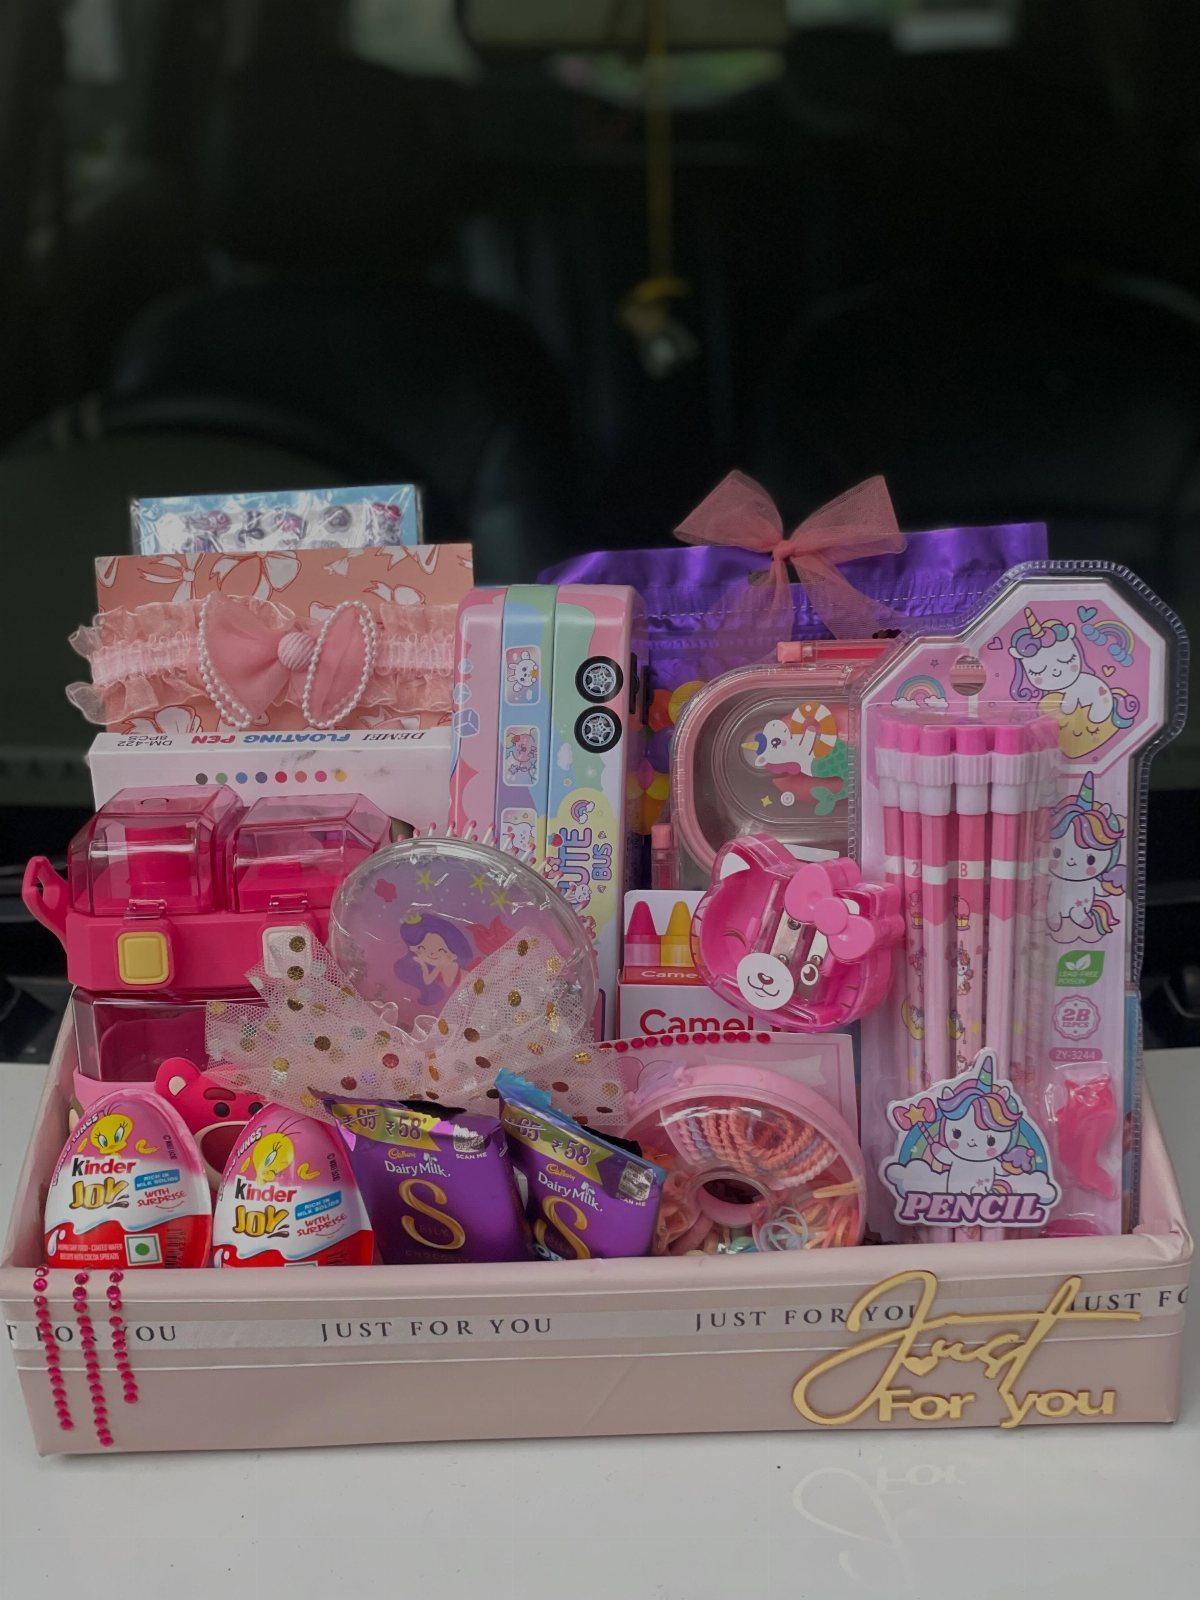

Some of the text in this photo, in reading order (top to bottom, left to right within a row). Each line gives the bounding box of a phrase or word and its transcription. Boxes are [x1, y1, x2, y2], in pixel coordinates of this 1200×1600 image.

[117, 739, 173, 747] DM-422
[190, 730, 425, 745] DEMEI FLOATING PEN
[591, 843, 613, 881] BUS
[640, 970, 702, 980] Came
[1061, 1008, 1092, 1022] 2B
[1055, 1049, 1096, 1060] ZY-3244
[71, 1156, 137, 1177] kinder
[476, 1151, 488, 1160] ME
[384, 1158, 447, 1178] Dairy Milk
[68, 1176, 130, 1210] JOY
[136, 1189, 187, 1208] SURPRISE
[144, 1187, 170, 1199] WITH
[234, 1177, 298, 1203] kinder
[537, 1171, 601, 1212] Dairy Milk
[900, 1193, 1046, 1224] PENCIL
[232, 1204, 290, 1238] JOY
[296, 1211, 349, 1238] SURPRISE
[304, 1213, 331, 1228] WITH
[320, 1317, 552, 1342] JUST FOR YOU
[695, 1310, 767, 1332] JUST
[784, 1308, 847, 1325] FOR
[793, 1269, 1142, 1426] Just
[877, 1388, 1118, 1429] For you
